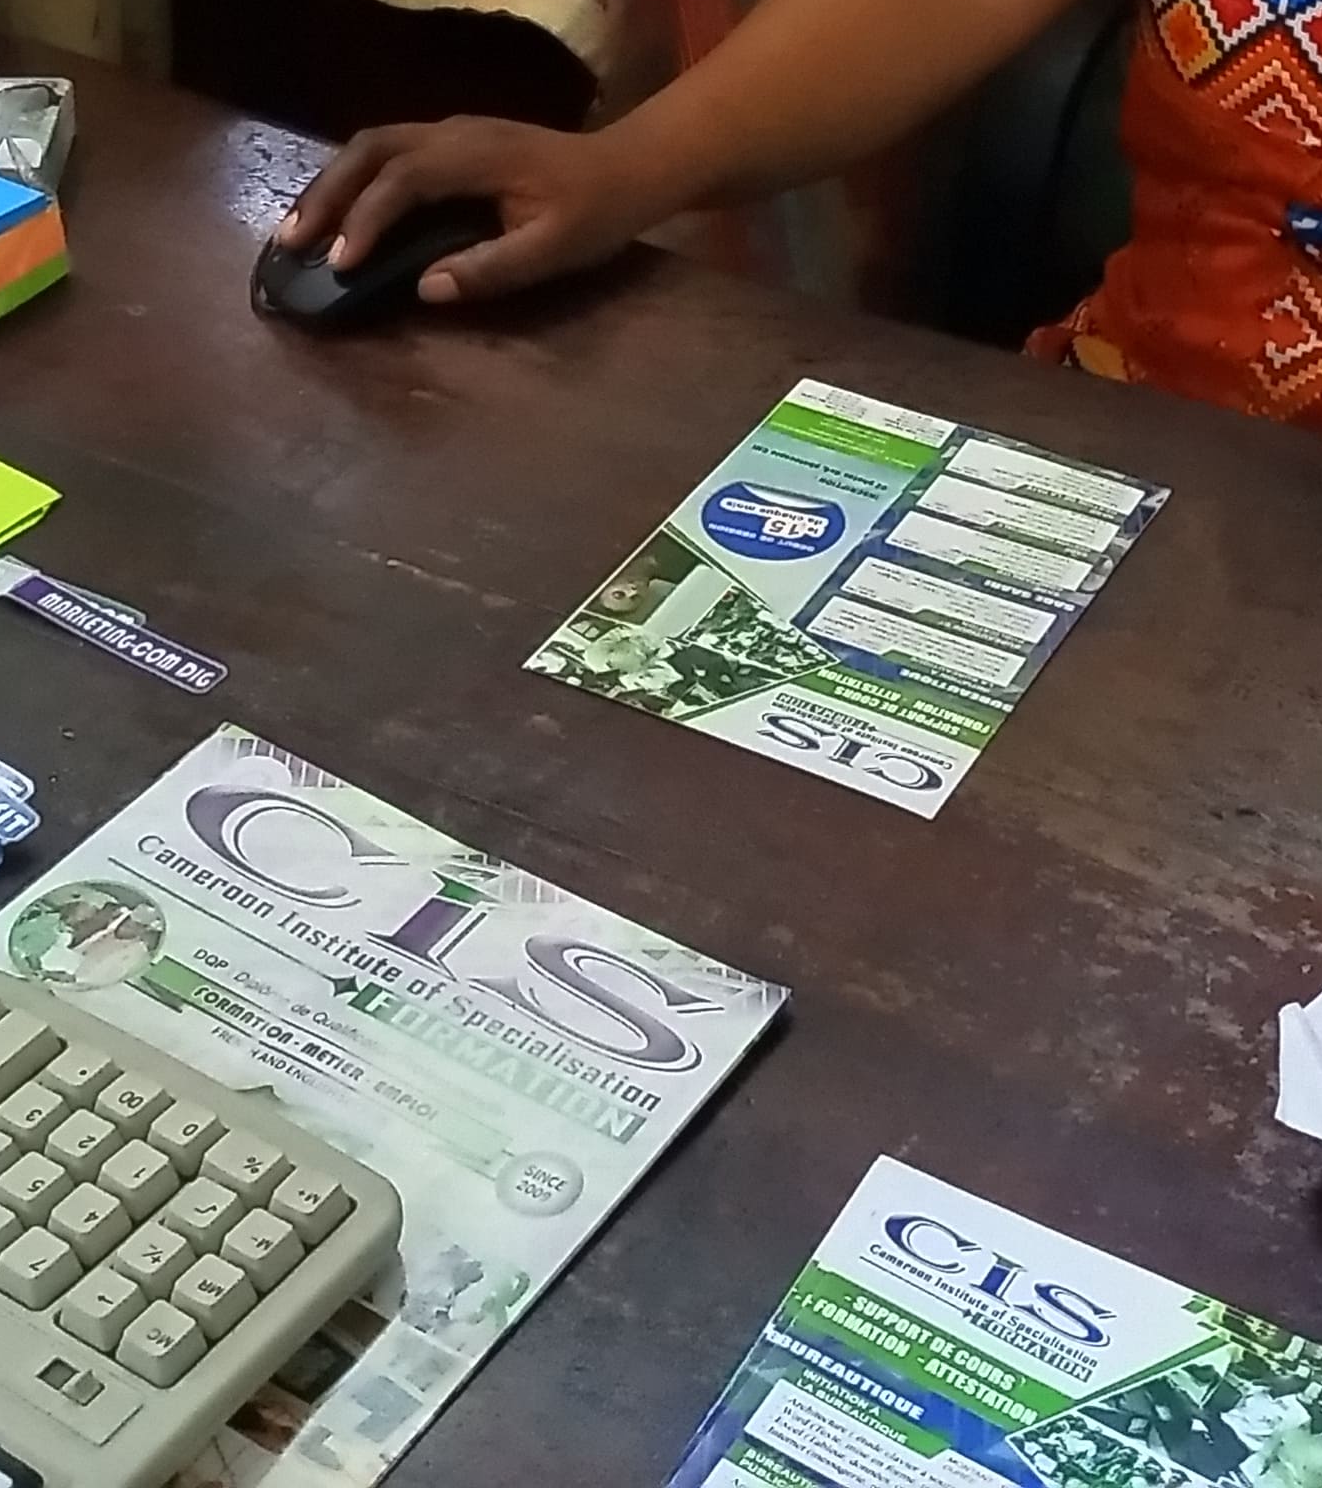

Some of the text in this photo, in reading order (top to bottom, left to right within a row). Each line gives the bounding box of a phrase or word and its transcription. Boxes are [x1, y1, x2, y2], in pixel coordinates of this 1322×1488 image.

[723, 498, 806, 525] chaque mois
[764, 517, 805, 539] 15
[37, 592, 216, 689] MARKETING-COM DIG
[816, 667, 992, 733] FORMATION ATTESTATION
[831, 684, 881, 708] COURS
[895, 707, 961, 735] SUPPORT
[746, 705, 953, 798] CIS
[184, 782, 724, 1076] CIS
[192, 947, 230, 971] DQP
[136, 832, 663, 1113] Cameroon Institute of Specialisation
[193, 986, 294, 1046] FORMATION
[302, 1040, 366, 1083] METIER
[259, 1049, 289, 1072] AND
[350, 980, 650, 1145] FORMATION
[117, 1090, 145, 1109] 00
[515, 1177, 553, 1203] 2009
[522, 1164, 569, 1194] SINCE
[197, 1278, 225, 1298] MR
[868, 1242, 1099, 1369] Cameroon Institute of Specialisation
[883, 1214, 1118, 1349] CIS
[146, 1327, 176, 1348] MC
[810, 1297, 1040, 1428] FORMATION ATTESTATION
[849, 1293, 1019, 1392] SUPPORT DE COURS
[973, 1313, 1094, 1384] FORMATION
[794, 1378, 910, 1445] LA BUREAUTIQUE
[800, 1368, 870, 1410] INITIATION
